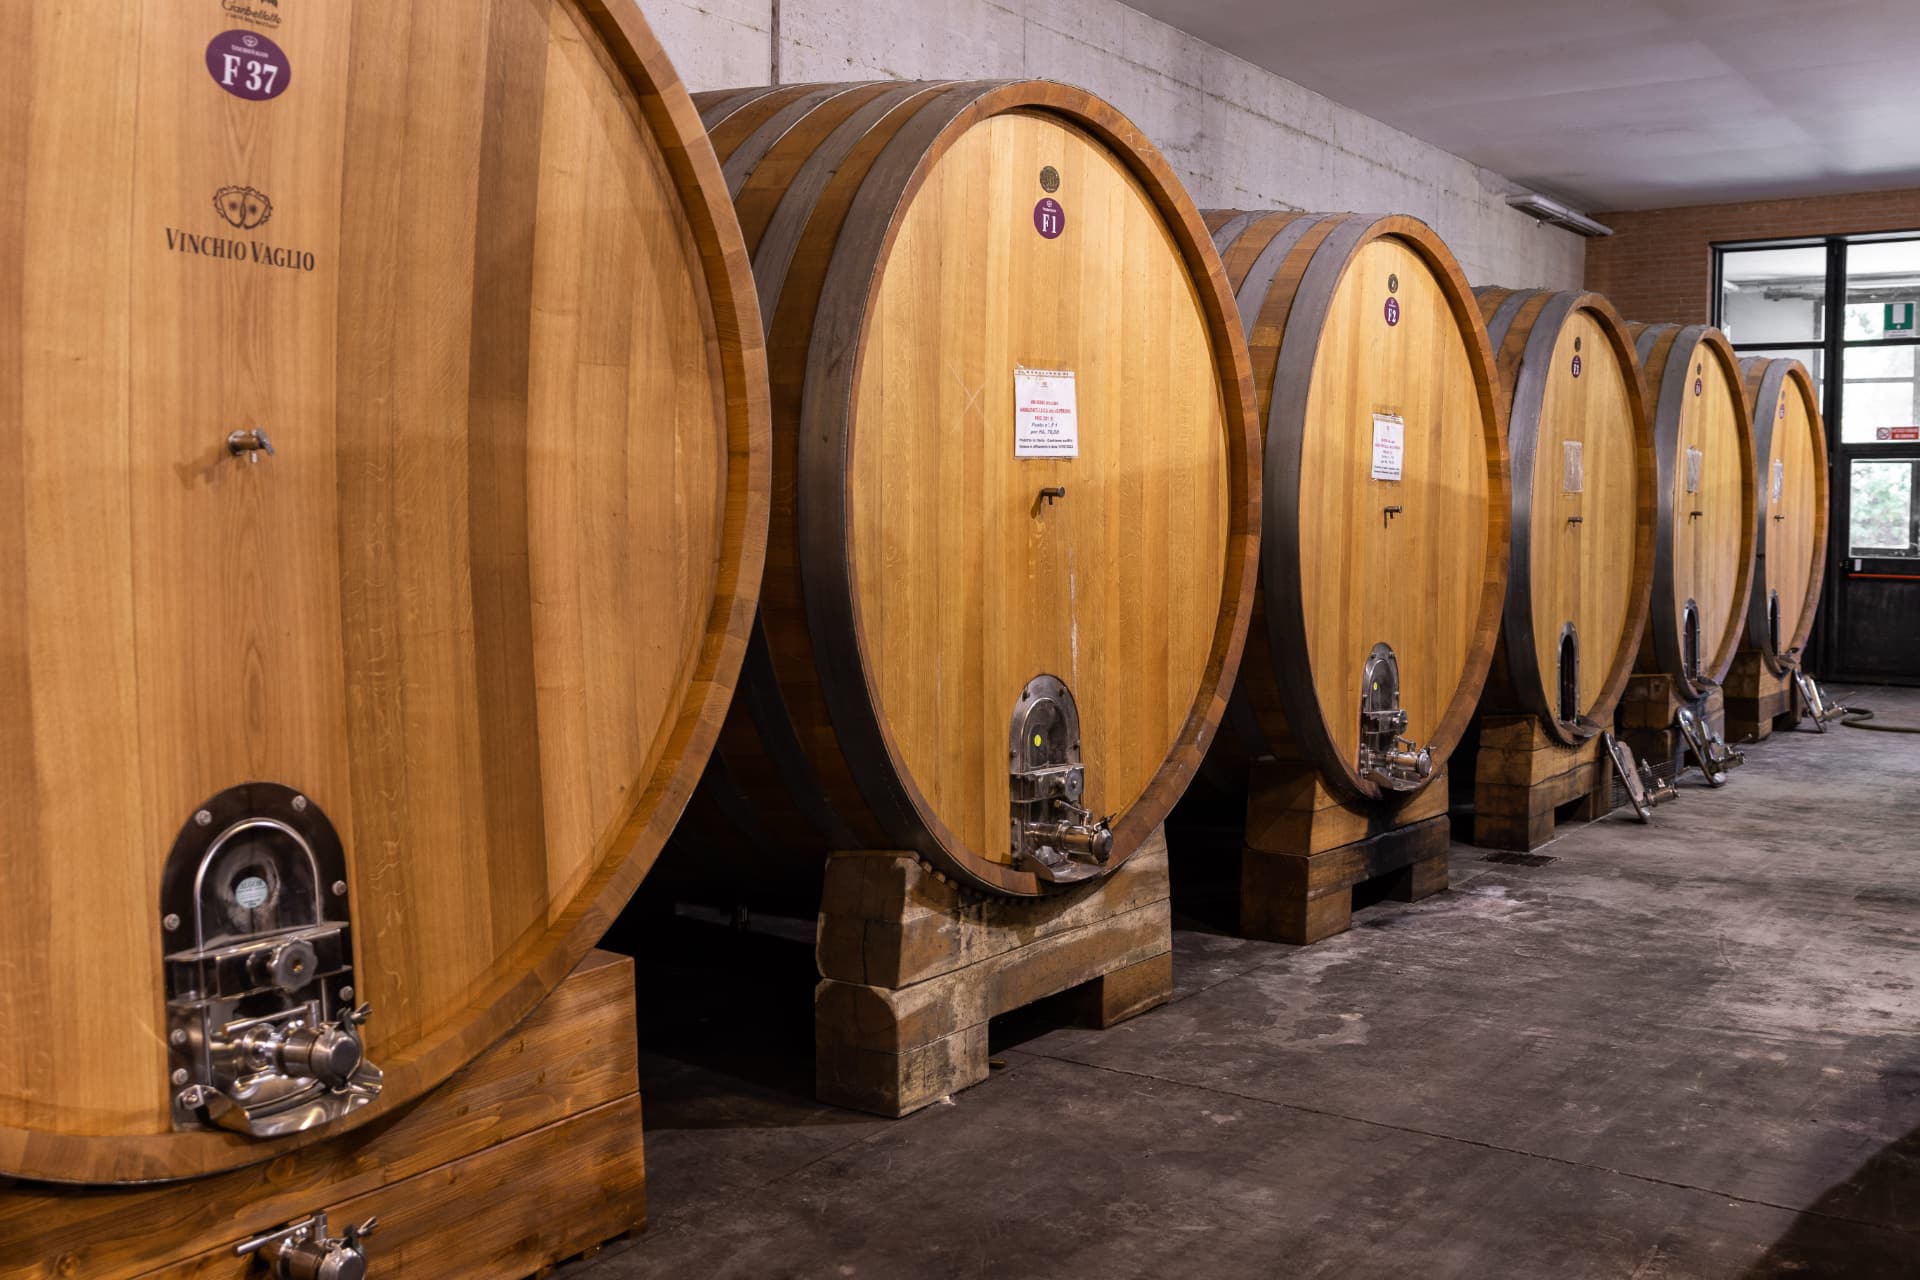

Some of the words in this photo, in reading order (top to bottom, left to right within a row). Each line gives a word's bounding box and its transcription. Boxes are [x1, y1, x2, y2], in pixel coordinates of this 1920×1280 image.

[221, 53, 241, 86] F
[246, 60, 279, 94] 37
[165, 227, 247, 261] VINCHIO
[250, 240, 315, 271] VAGLIO
